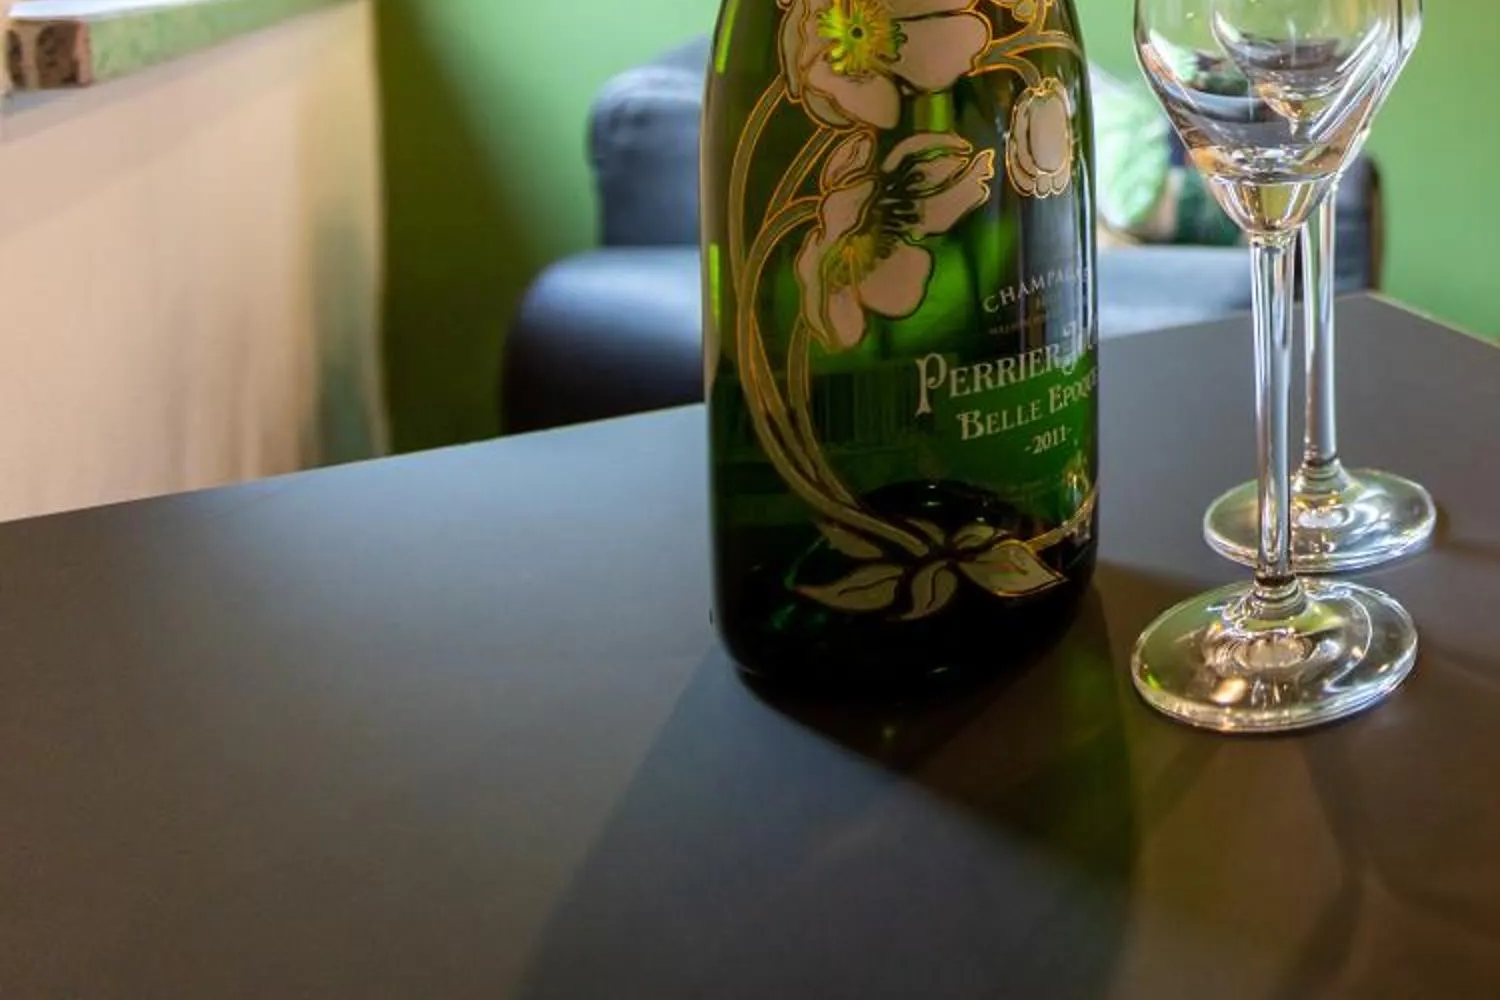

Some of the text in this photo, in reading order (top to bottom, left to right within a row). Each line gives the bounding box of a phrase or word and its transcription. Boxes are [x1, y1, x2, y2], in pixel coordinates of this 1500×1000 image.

[982, 267, 1088, 313] CHAMPA
[955, 367, 1097, 440] BELLE EPOQ
